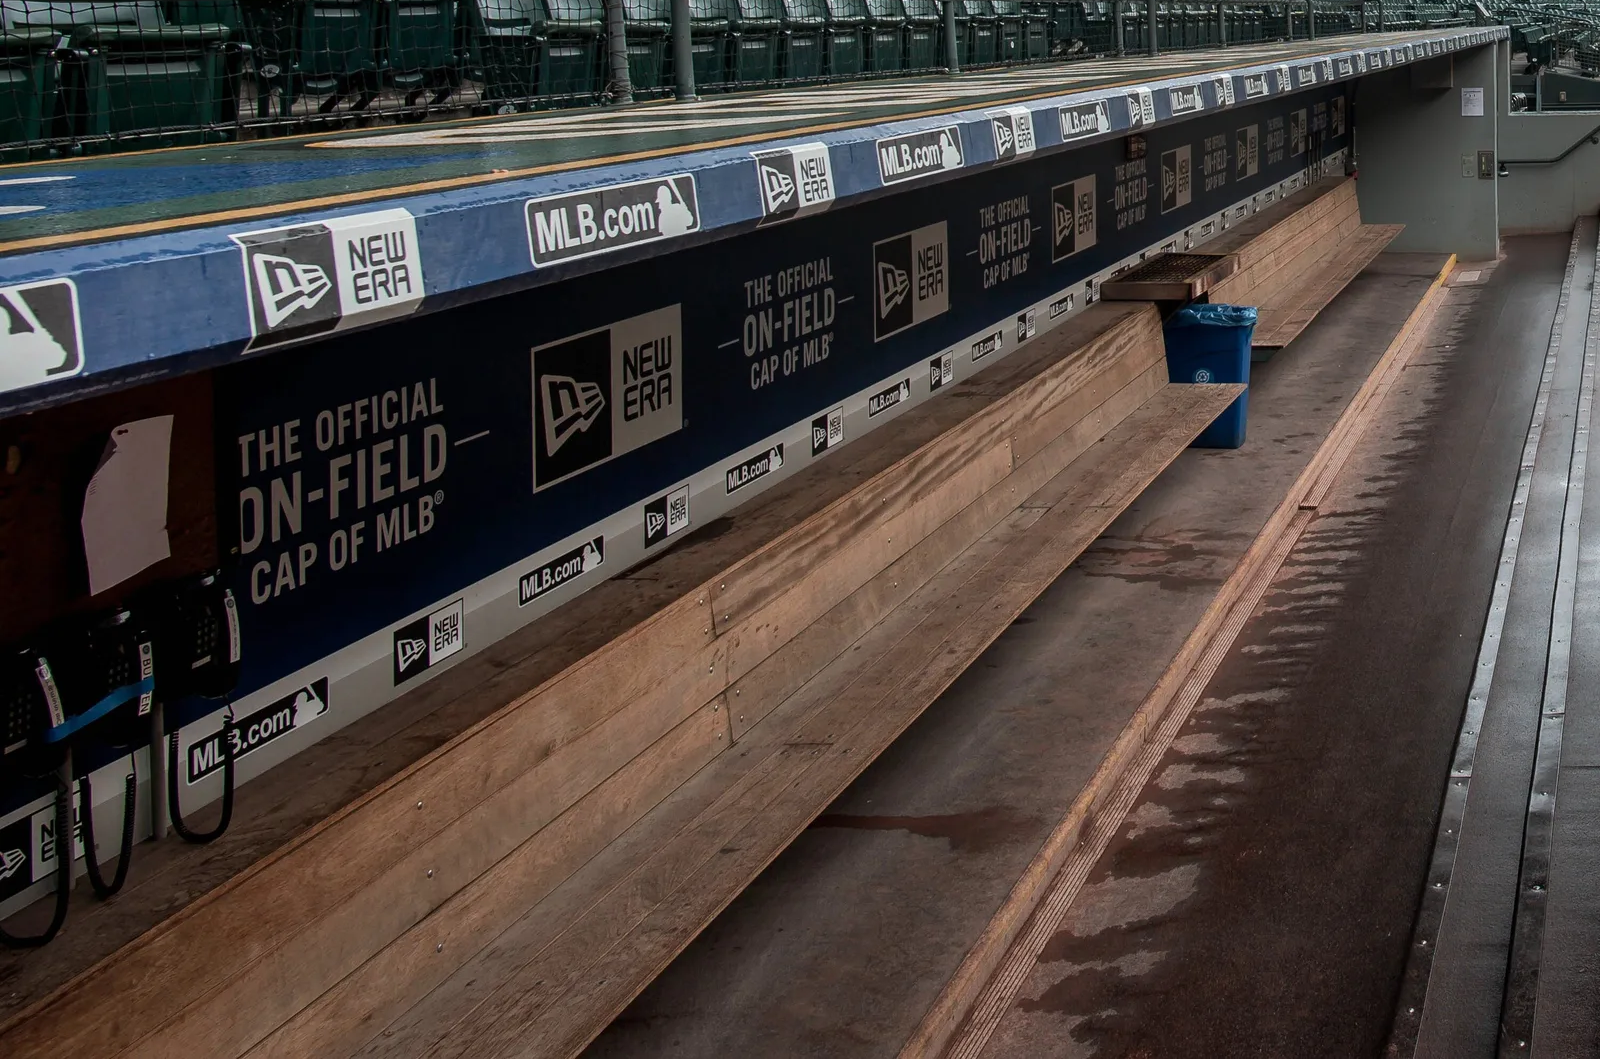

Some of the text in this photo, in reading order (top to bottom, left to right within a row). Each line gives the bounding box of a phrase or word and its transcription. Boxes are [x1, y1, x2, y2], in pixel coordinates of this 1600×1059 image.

[1171, 93, 1195, 109] MLB.com
[1015, 115, 1030, 133] NEW
[1061, 113, 1097, 135] MLB.com
[1017, 132, 1032, 149] ERA
[800, 157, 825, 181] NEW
[881, 141, 941, 177] MLB.com
[803, 179, 830, 203] ERA
[1077, 191, 1093, 210] NEW
[1114, 177, 1147, 210] ON-FIELD
[980, 195, 1029, 228] THE OFFICIAL
[1077, 212, 1094, 235] ERA
[534, 201, 655, 253] MLB.com
[980, 219, 1031, 264] ON-FIELD
[348, 230, 405, 270] NEW
[917, 243, 943, 274] NEW
[353, 265, 411, 305] ERA
[744, 256, 834, 308] THE OFFICIAL
[918, 273, 944, 301] ERA
[983, 267, 1000, 289] CAP
[1001, 264, 1010, 281] OF
[743, 288, 835, 357] ON-FIELD
[622, 335, 672, 385] NEW
[972, 341, 994, 358] MLB.com
[751, 357, 778, 390] CAP
[783, 344, 799, 375] OF
[623, 374, 673, 422] ERA
[870, 387, 900, 415] MLB.com
[239, 378, 444, 478] THE OFFICIAL
[828, 410, 842, 426] NEW
[829, 424, 843, 440] ERA
[240, 424, 447, 555] ON-FIELD
[728, 458, 769, 493] MLB.com
[669, 495, 687, 512] NEW
[670, 508, 687, 525] ERA
[251, 548, 318, 605] CAP
[329, 521, 365, 571] OF
[521, 553, 582, 601] MLB.com
[433, 610, 459, 637] NEW
[434, 627, 459, 653] ERA
